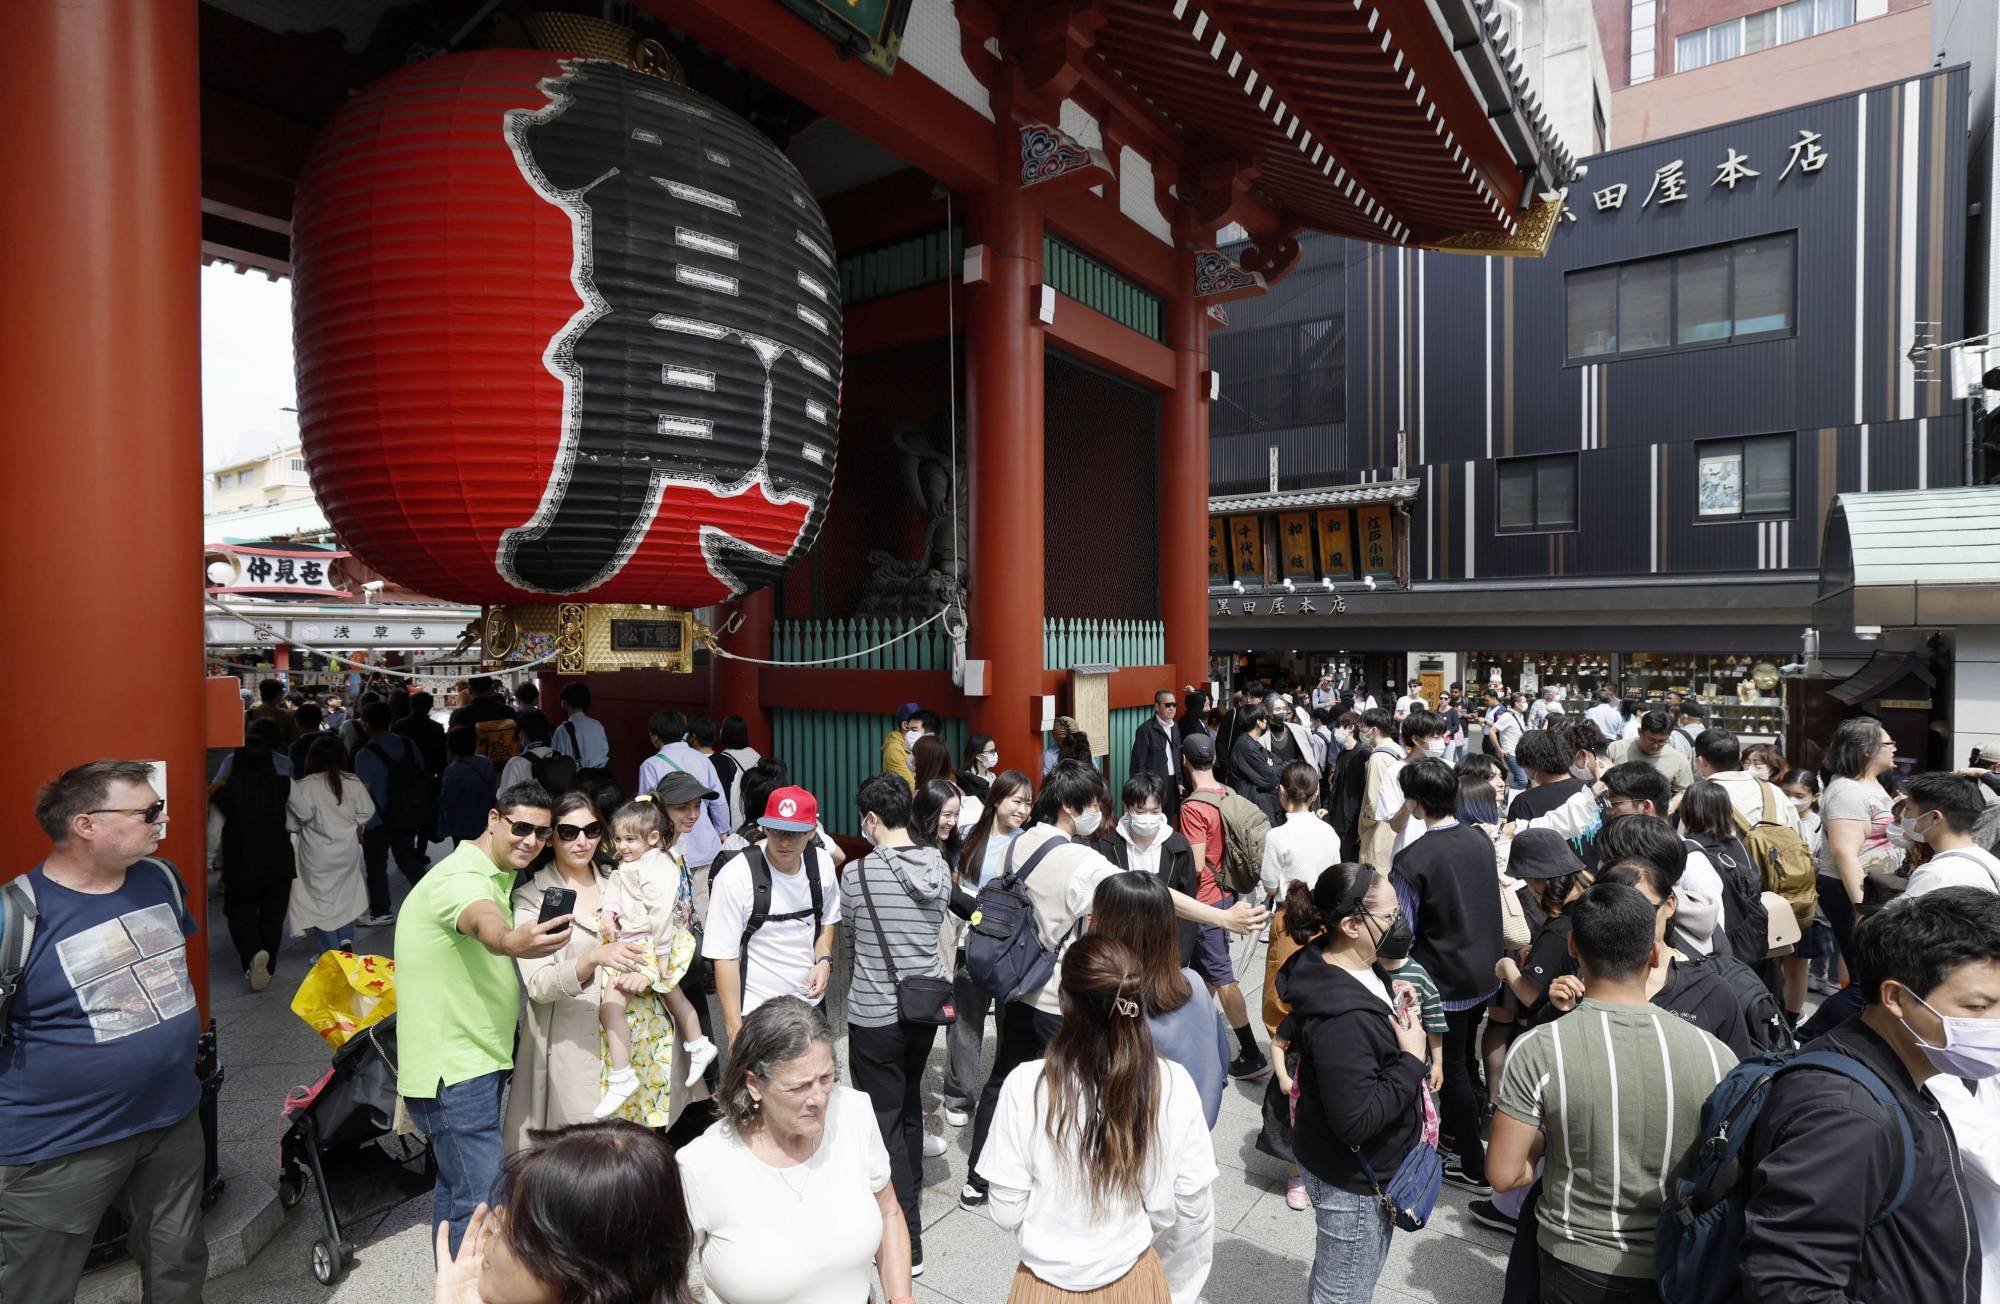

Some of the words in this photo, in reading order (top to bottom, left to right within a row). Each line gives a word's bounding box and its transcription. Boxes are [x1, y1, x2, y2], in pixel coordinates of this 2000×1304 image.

[496, 57, 843, 598] 雷門
[246, 556, 324, 586] 仲見世
[1216, 594, 1347, 616] 黒田屋本店
[333, 625, 426, 640] 浅草寺
[780, 801, 795, 814] M
